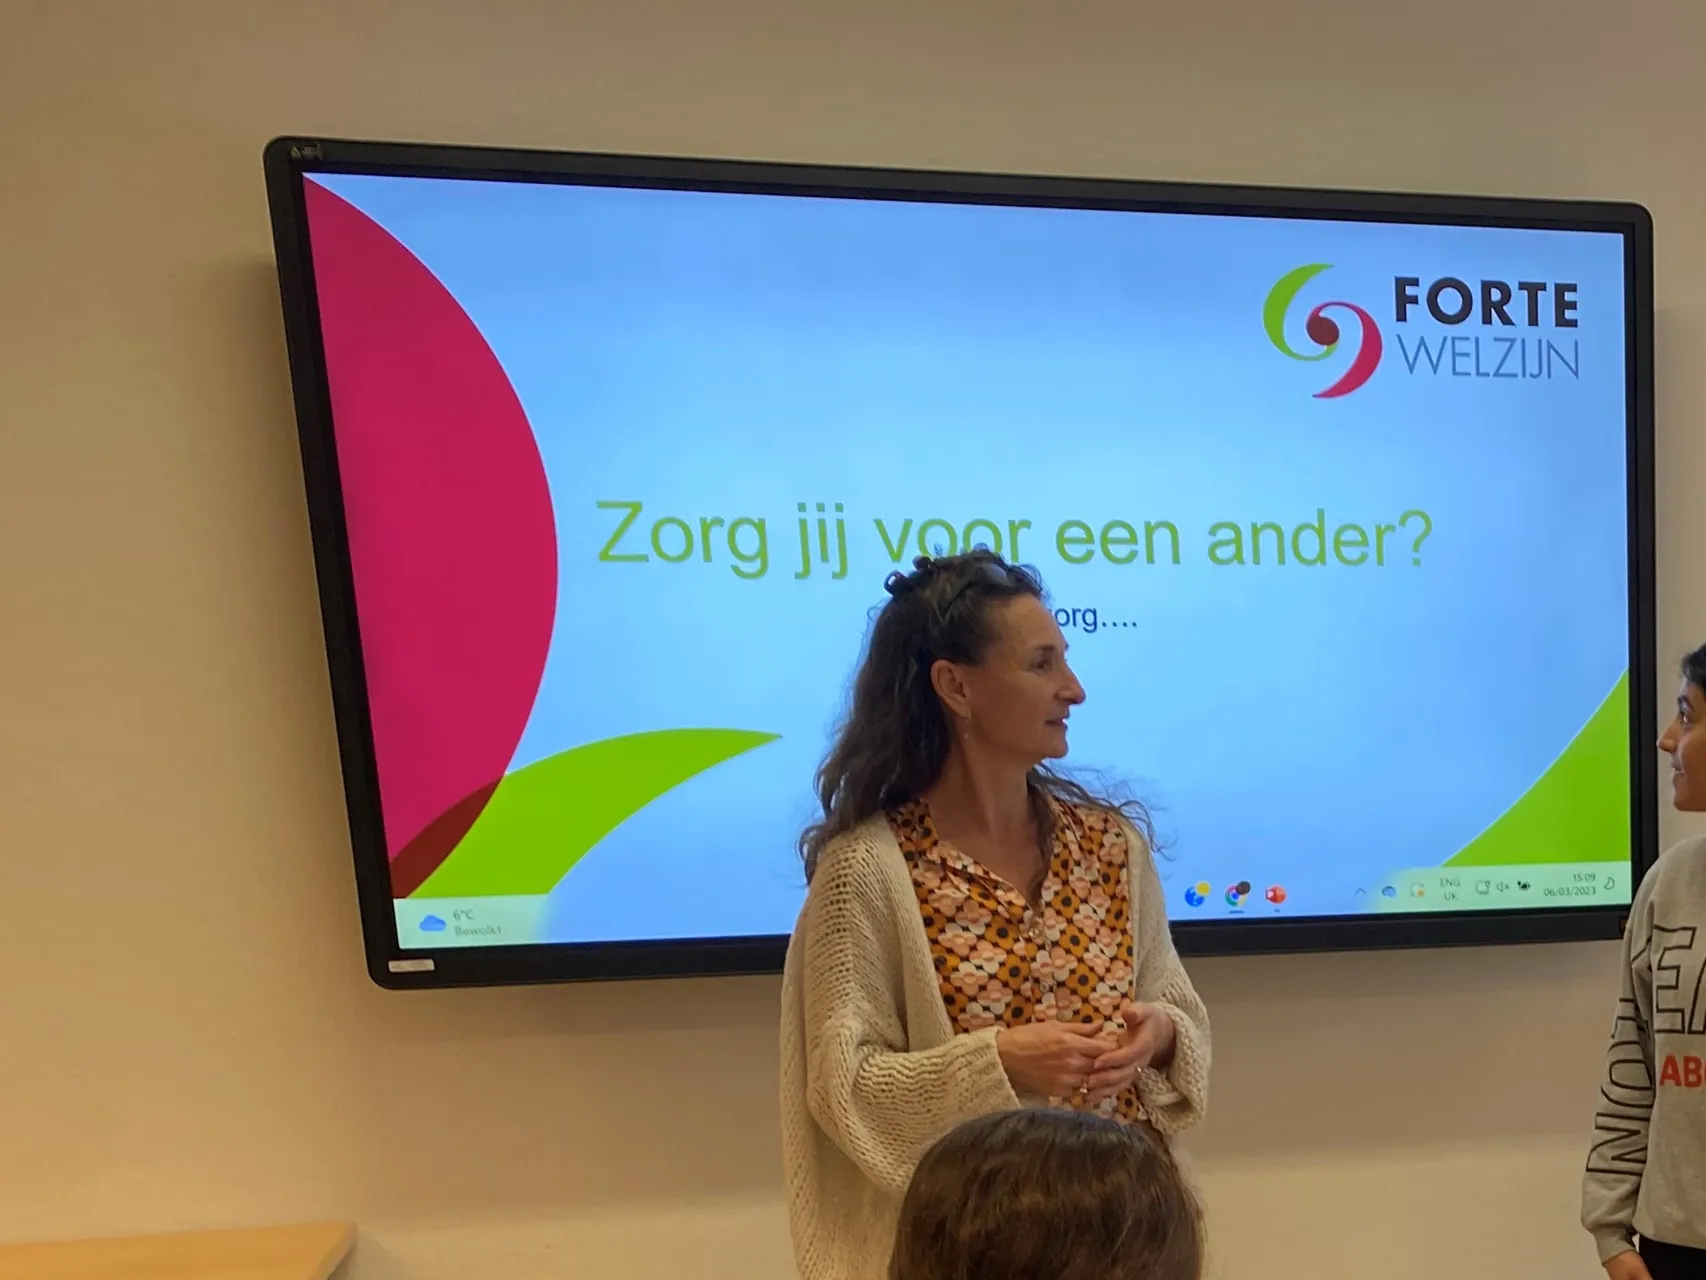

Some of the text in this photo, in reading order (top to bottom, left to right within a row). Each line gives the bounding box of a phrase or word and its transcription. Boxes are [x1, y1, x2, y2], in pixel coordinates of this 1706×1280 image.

[1394, 276, 1578, 328] FORTE
[1396, 333, 1579, 379] WELZIJN
[596, 500, 1432, 580] Zorg jij voor een ander?
[1048, 607, 1138, 634] org....
[1440, 877, 1461, 888] ENG
[1444, 891, 1458, 901] UK
